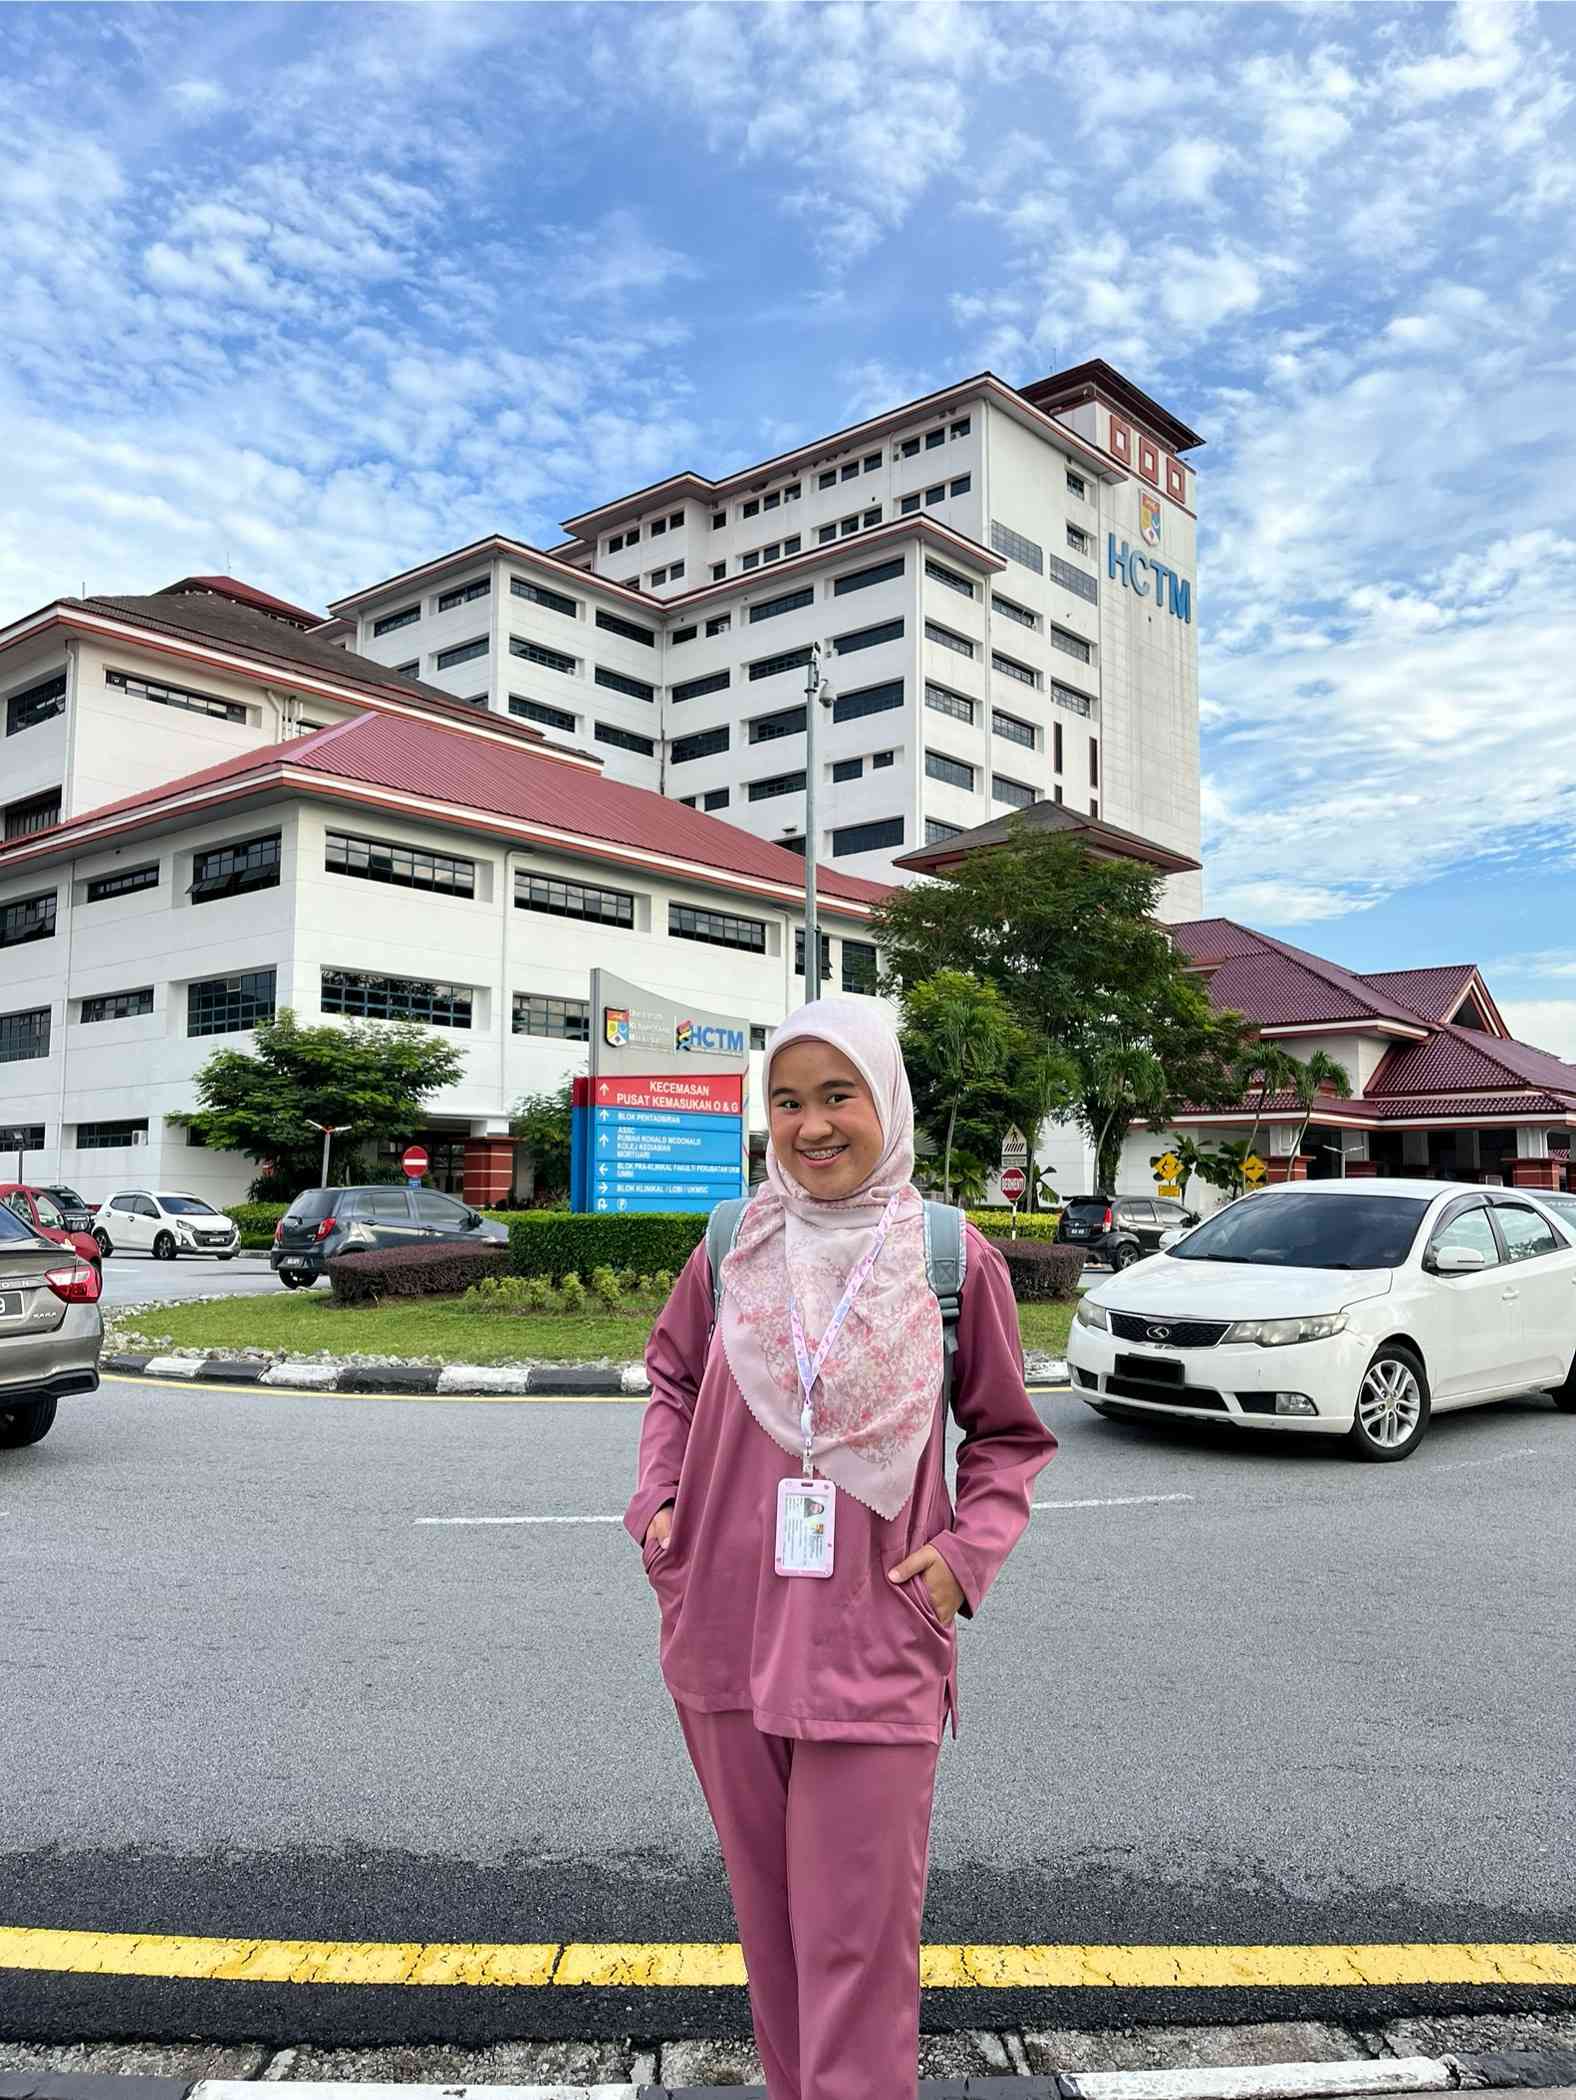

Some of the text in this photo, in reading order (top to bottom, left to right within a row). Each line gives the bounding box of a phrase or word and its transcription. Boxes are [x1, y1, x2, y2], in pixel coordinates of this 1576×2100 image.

[1109, 532, 1191, 624] HCTM
[690, 1024, 743, 1051] HCTM
[650, 1081, 709, 1095] KECEMASAN
[616, 1093, 650, 1106] PUSAT
[652, 1095, 712, 1111] KEMASUKAN
[722, 1102, 731, 1112] &
[731, 1102, 739, 1113] G
